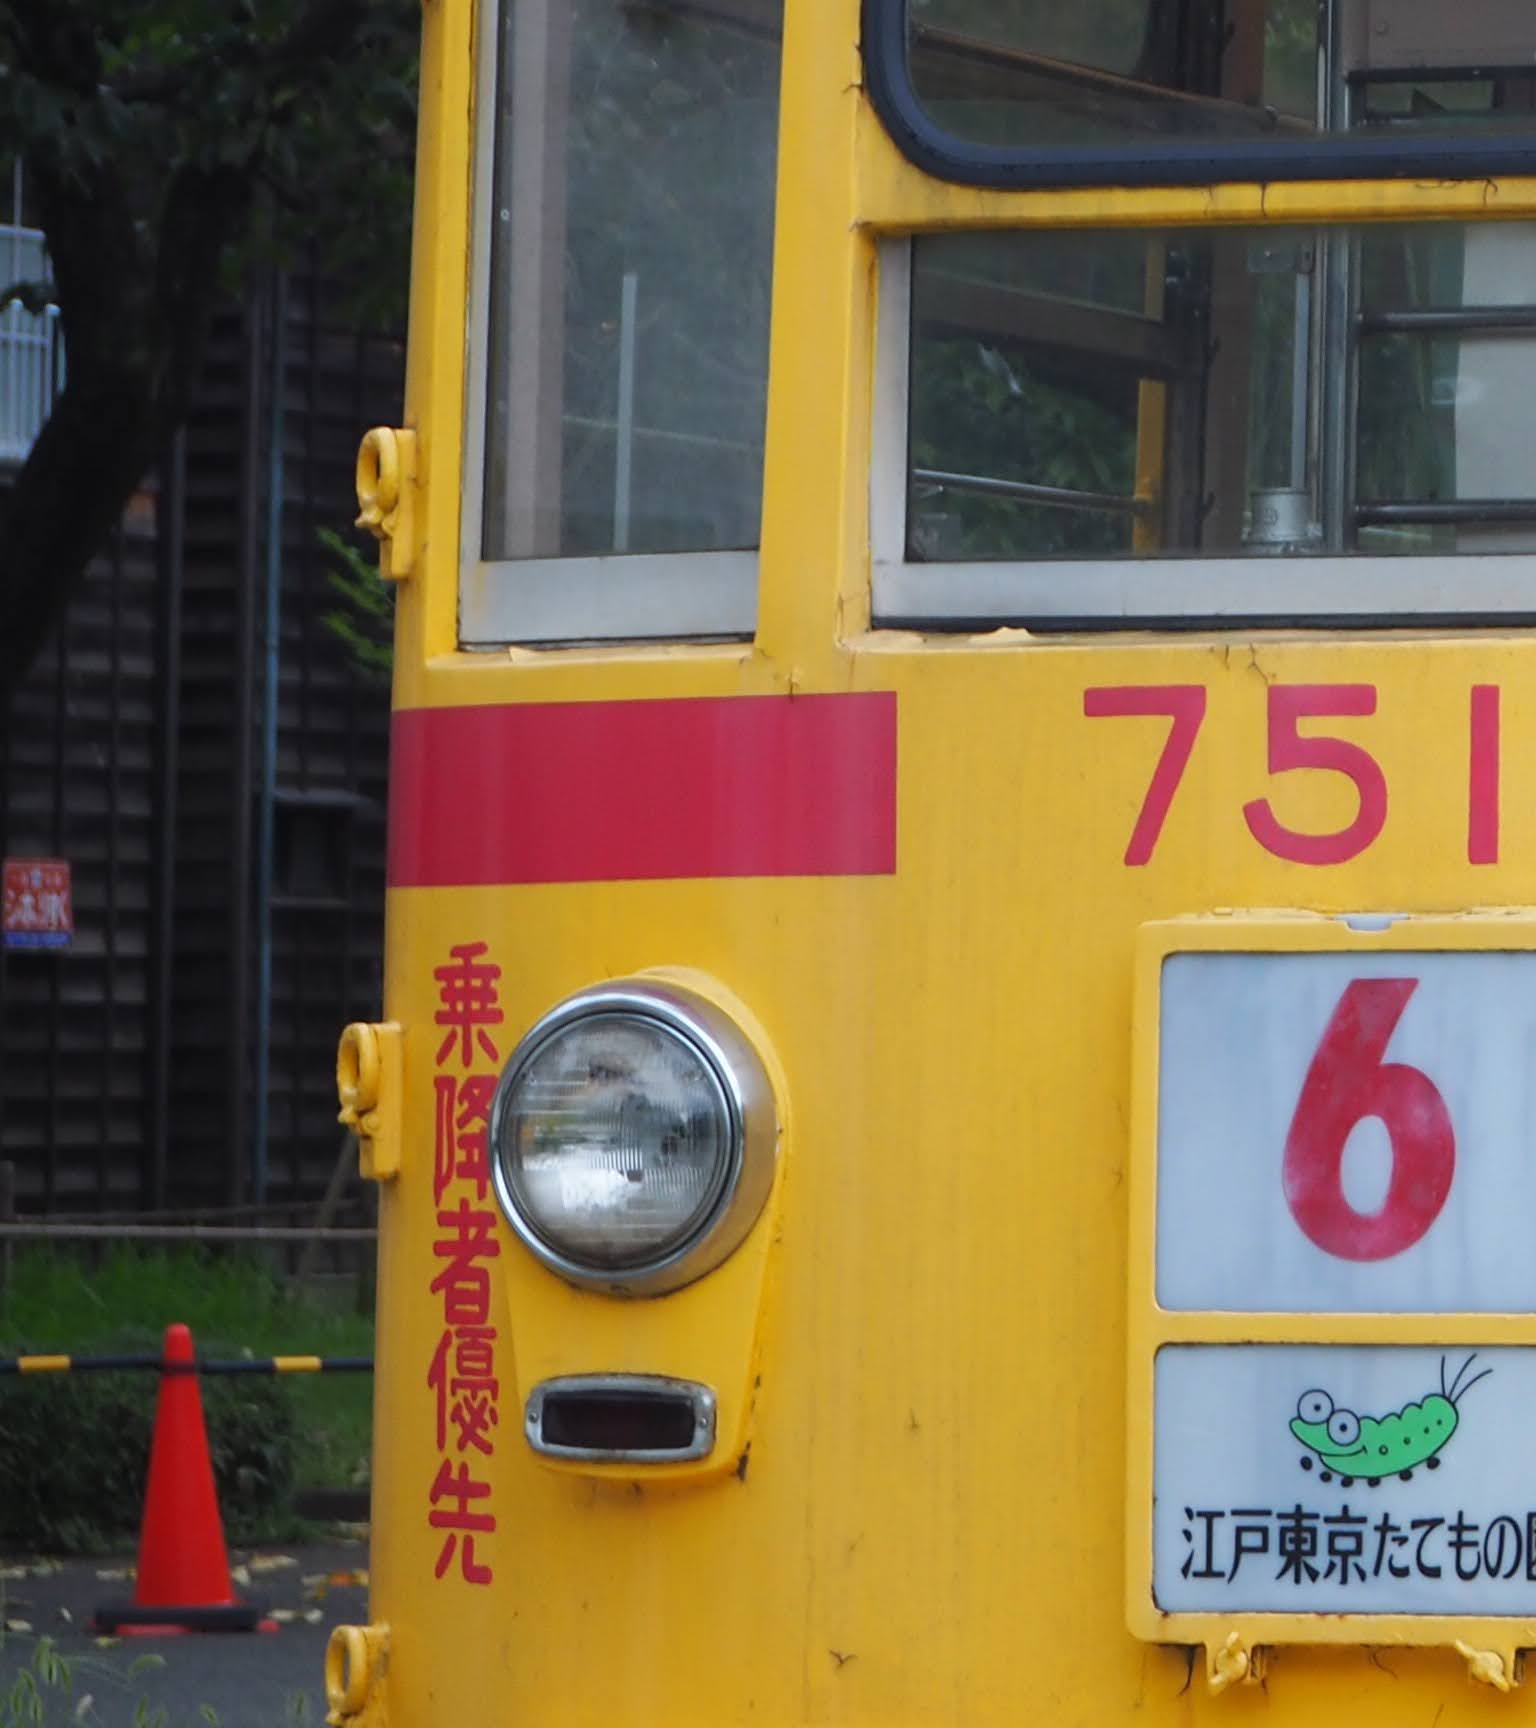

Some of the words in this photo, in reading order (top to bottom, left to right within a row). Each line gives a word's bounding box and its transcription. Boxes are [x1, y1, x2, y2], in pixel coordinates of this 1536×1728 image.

[427, 941, 505, 1587] 乗降者優先
[1281, 977, 1456, 1262] 6
